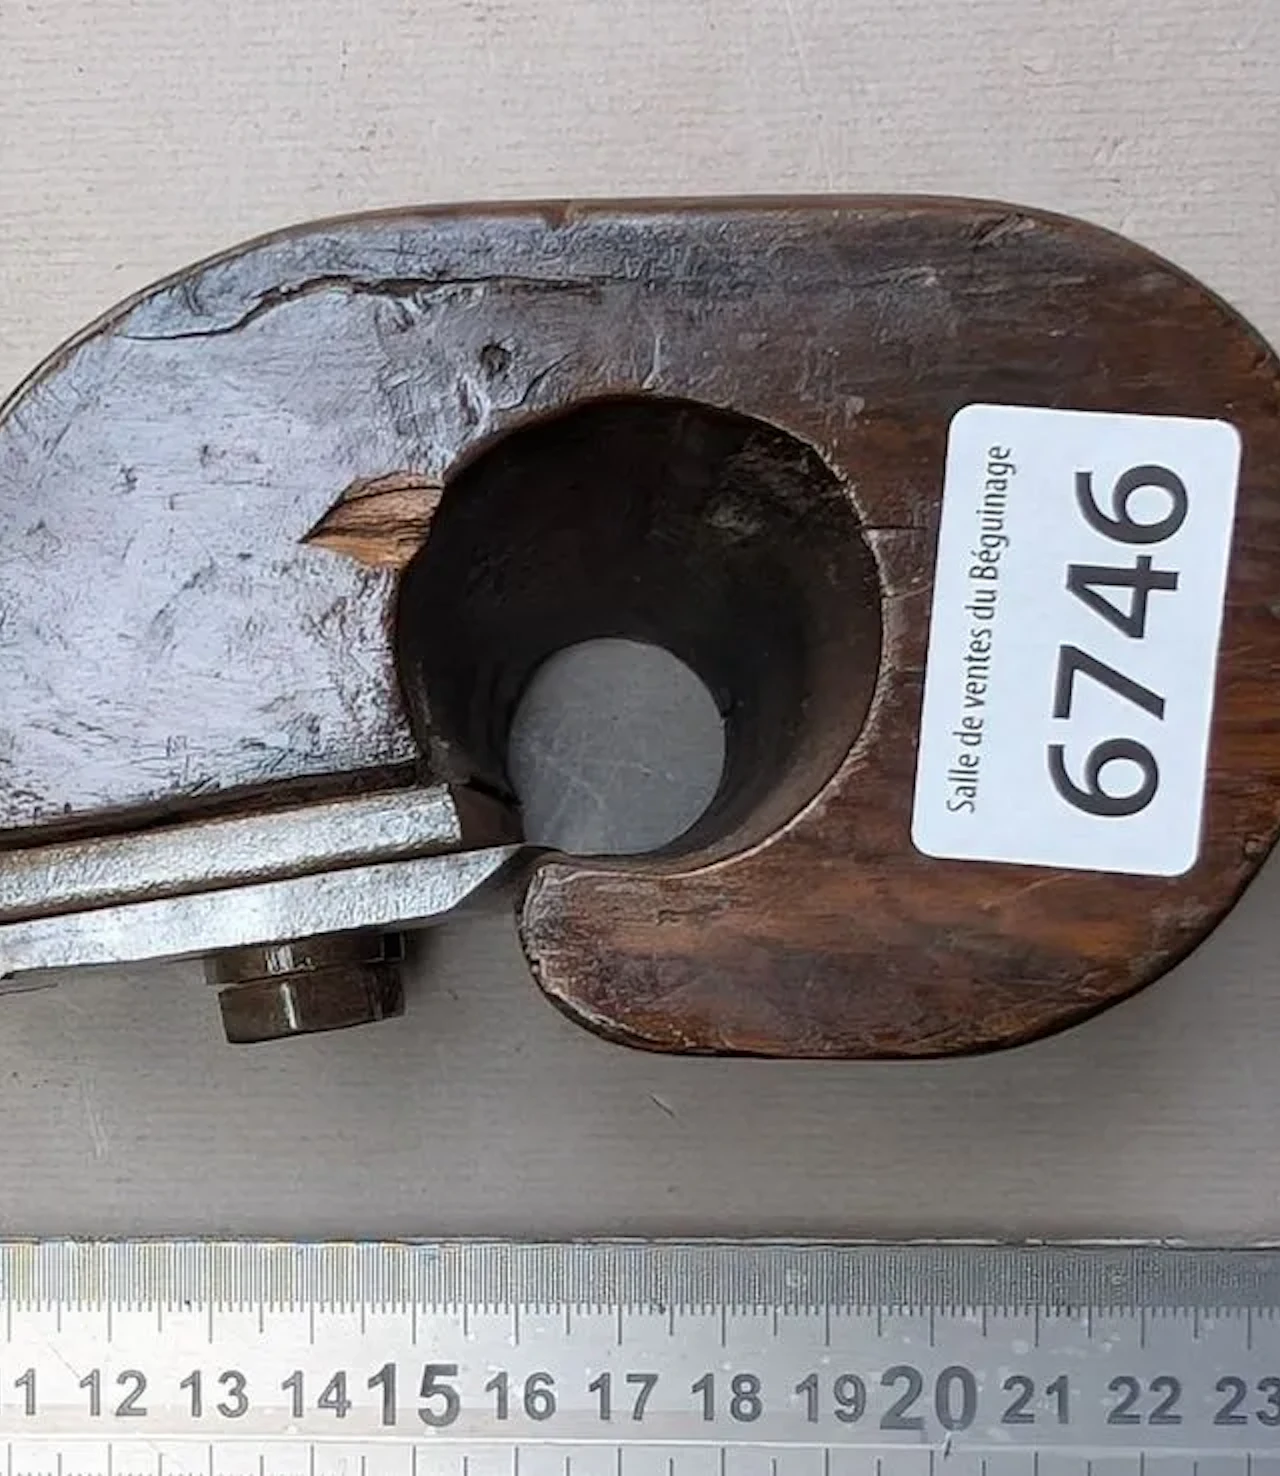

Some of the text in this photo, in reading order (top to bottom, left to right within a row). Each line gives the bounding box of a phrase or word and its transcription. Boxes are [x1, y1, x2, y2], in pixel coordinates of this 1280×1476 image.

[946, 445, 1017, 814] Salle de ventes du Béguinage
[1048, 463, 1189, 819] 6746
[78, 1367, 149, 1419] 12
[179, 1369, 250, 1419] 13
[280, 1369, 353, 1420] 14
[367, 1362, 462, 1429] 15
[484, 1371, 557, 1423] 16
[588, 1371, 659, 1424] 17
[691, 1372, 763, 1423] 18
[794, 1372, 867, 1425] 19
[879, 1365, 978, 1432] 20
[1000, 1374, 1069, 1425] 21
[1106, 1375, 1183, 1425] 22
